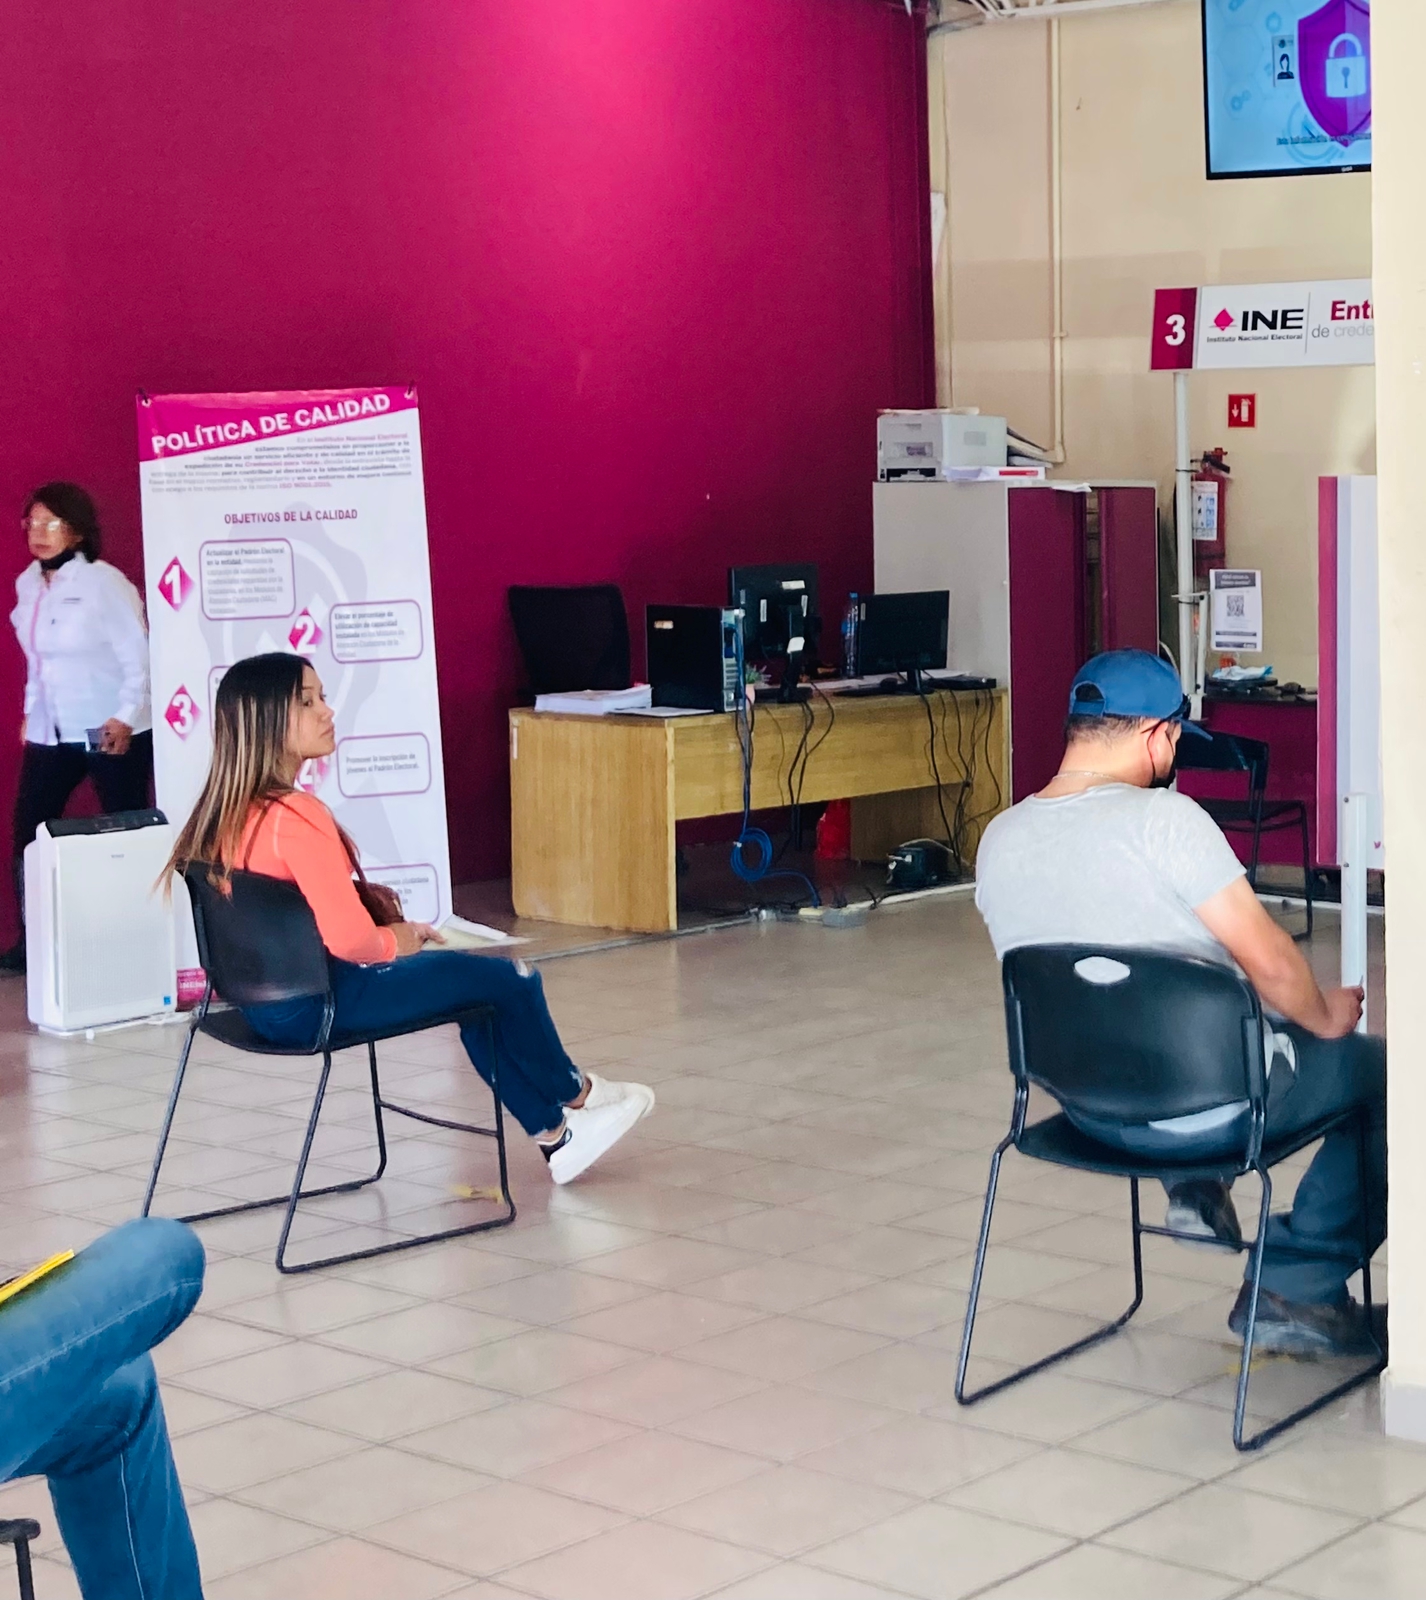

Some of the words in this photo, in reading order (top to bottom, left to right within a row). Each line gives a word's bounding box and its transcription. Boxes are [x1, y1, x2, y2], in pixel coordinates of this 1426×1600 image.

[1165, 314, 1186, 346] 3
[1241, 308, 1304, 332] INE
[1331, 299, 1374, 321] Ent
[1312, 324, 1330, 338] de
[152, 420, 256, 454] POLÍTICA
[260, 412, 290, 434] DE
[295, 394, 390, 427] CALIDAD
[224, 512, 280, 524] OBJETIVOS
[284, 511, 296, 522] DE
[300, 511, 312, 521] LA
[316, 509, 358, 520] CALIDAD
[165, 564, 182, 604] 1
[295, 616, 316, 653] 2
[172, 693, 194, 734] 3
